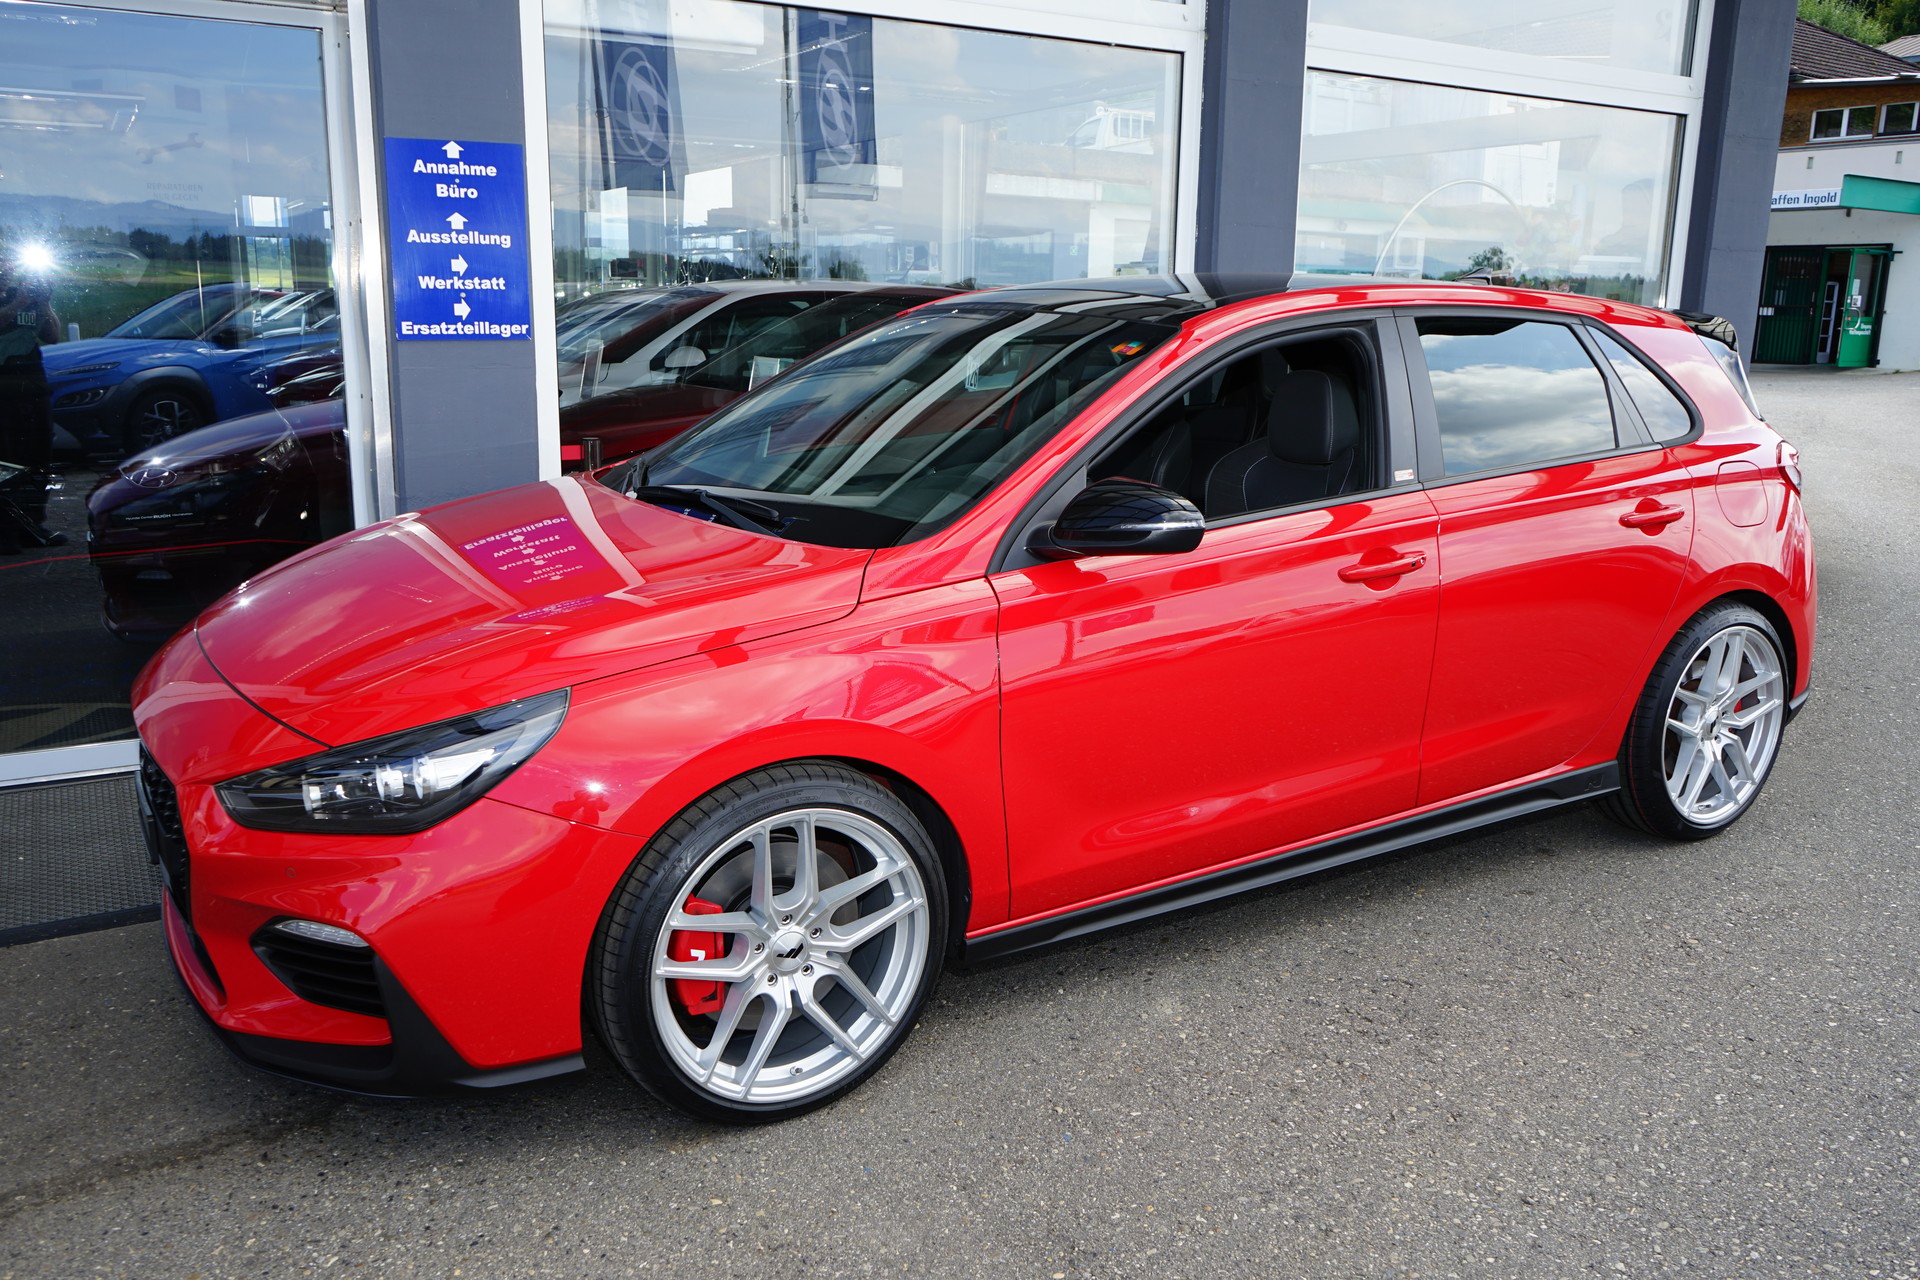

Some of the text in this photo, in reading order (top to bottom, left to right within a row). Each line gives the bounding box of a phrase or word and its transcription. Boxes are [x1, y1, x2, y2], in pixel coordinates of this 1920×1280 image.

[413, 159, 497, 177] Annahme
[435, 183, 478, 199] Büro
[1771, 192, 1837, 206] affen Ingold
[407, 229, 511, 249] Ausstellung
[418, 275, 506, 291] Werkstatt
[401, 321, 529, 338] Ersatzteillager
